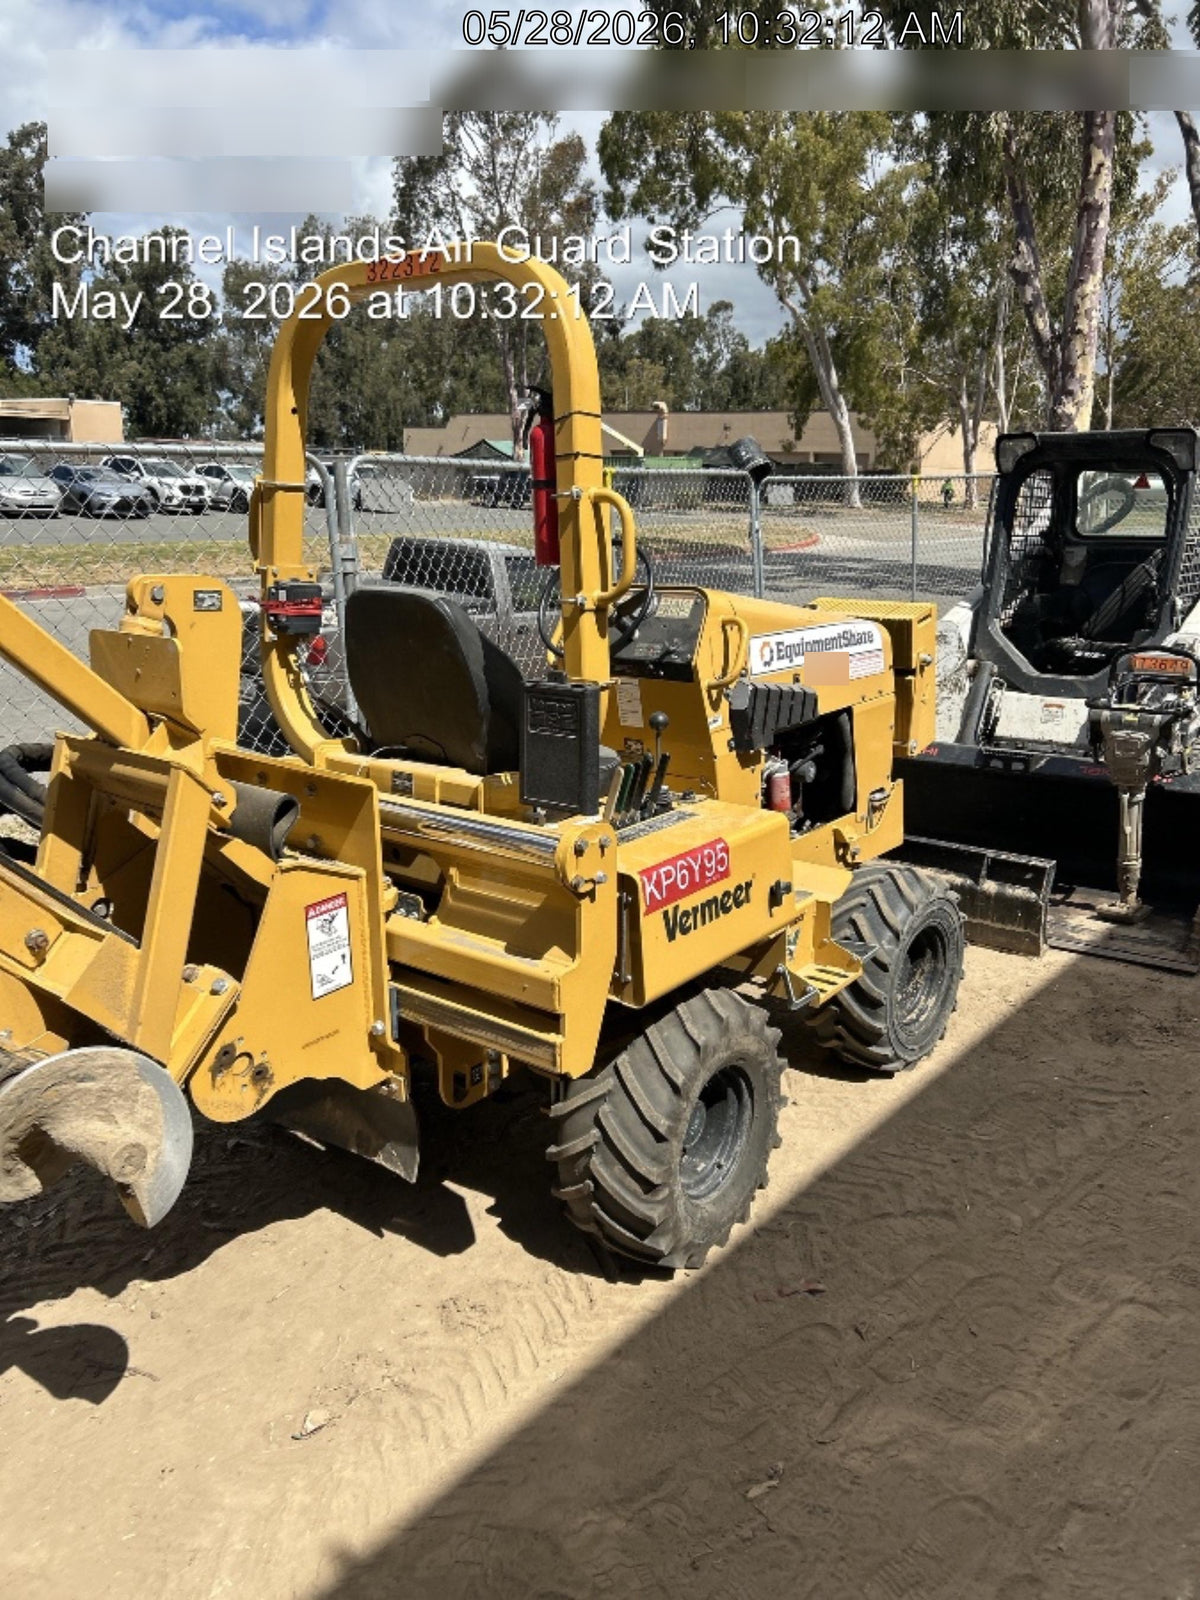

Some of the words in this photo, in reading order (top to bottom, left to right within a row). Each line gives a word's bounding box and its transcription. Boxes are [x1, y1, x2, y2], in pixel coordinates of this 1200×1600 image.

[774, 629, 875, 663] EquipmentShare
[642, 842, 728, 906] KP6Y95
[662, 880, 753, 943] Vermeer
